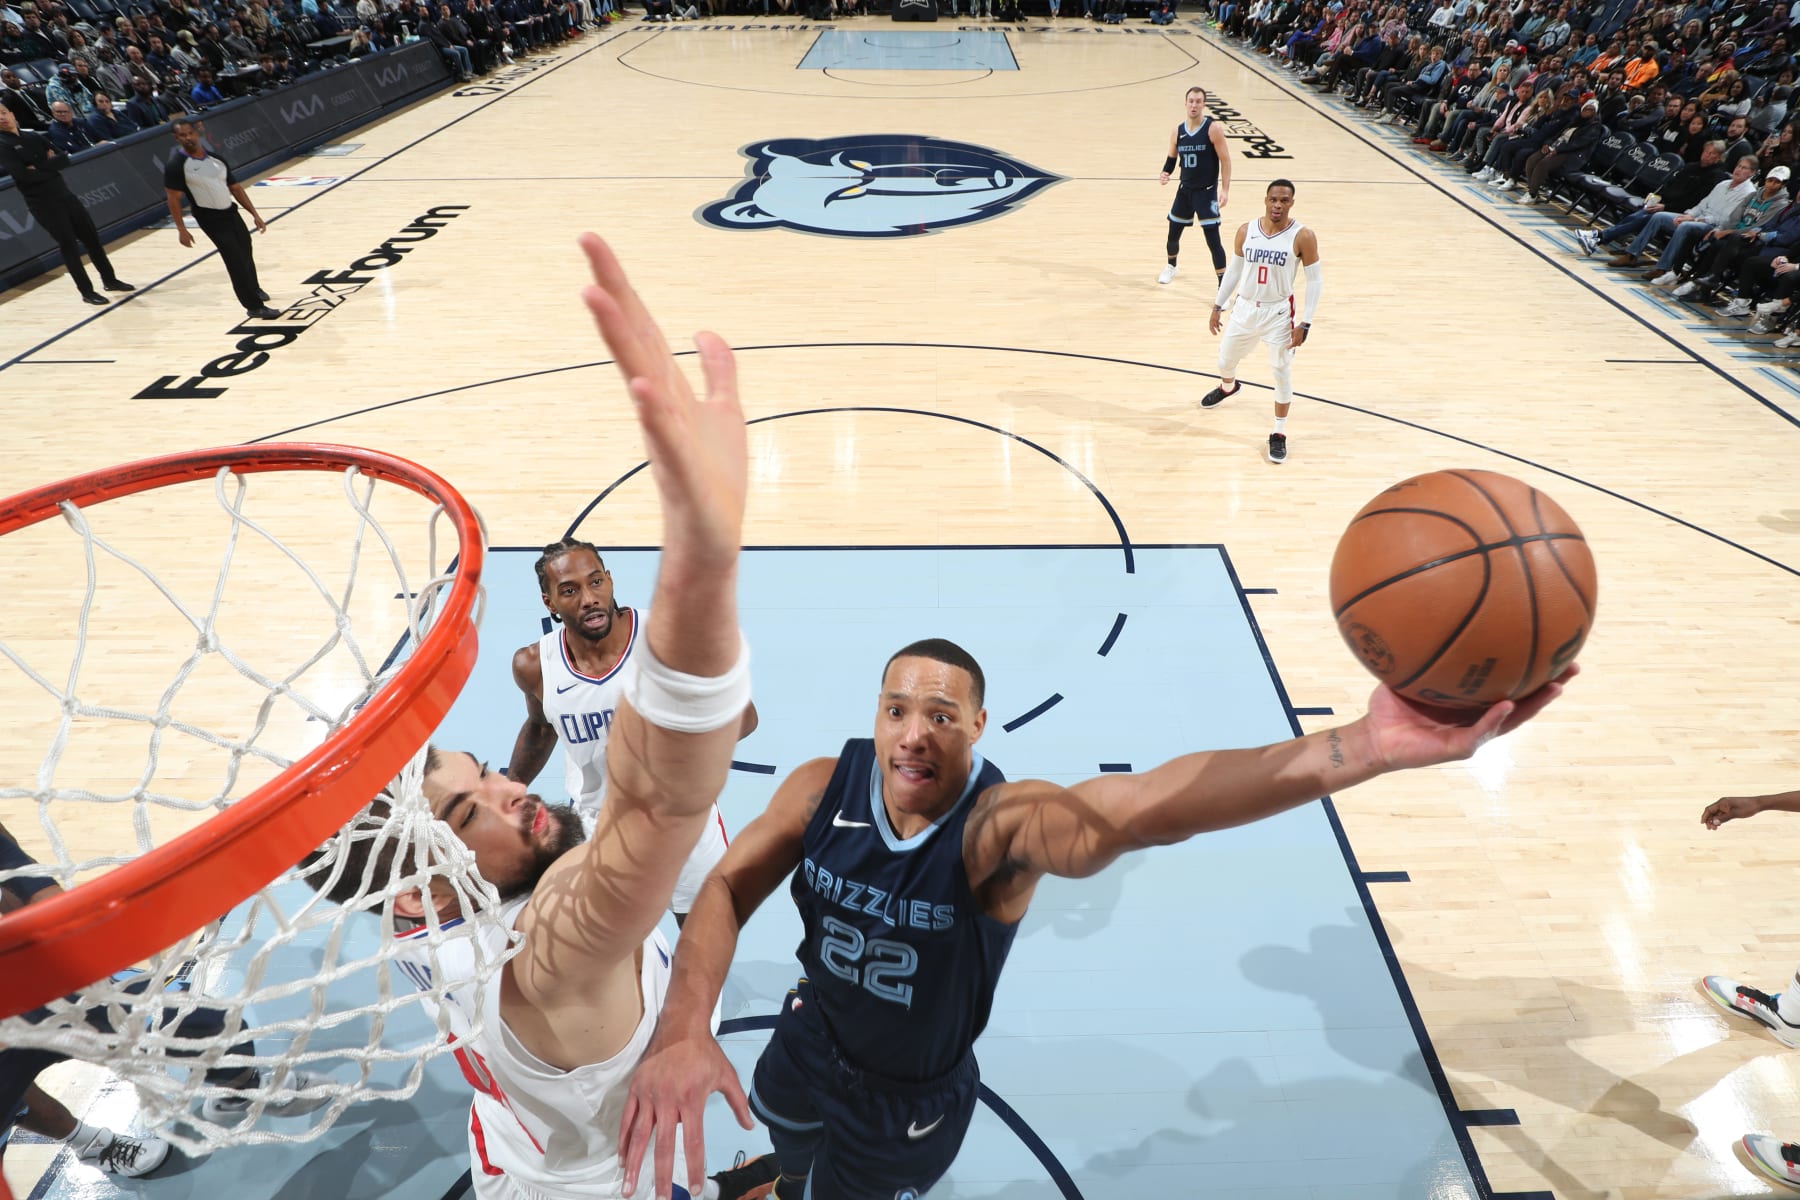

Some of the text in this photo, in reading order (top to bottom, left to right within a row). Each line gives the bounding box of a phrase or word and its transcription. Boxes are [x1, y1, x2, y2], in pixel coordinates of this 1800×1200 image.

[1183, 153, 1198, 168] 10
[78, 182, 121, 208] OSSETT
[1245, 247, 1288, 267] CLIPPERS
[1257, 266, 1268, 284] 0
[131, 205, 471, 399] FedExForum
[560, 708, 615, 744] CLIPP
[804, 857, 954, 931] GRIZZLIES
[820, 915, 919, 1009] 22
